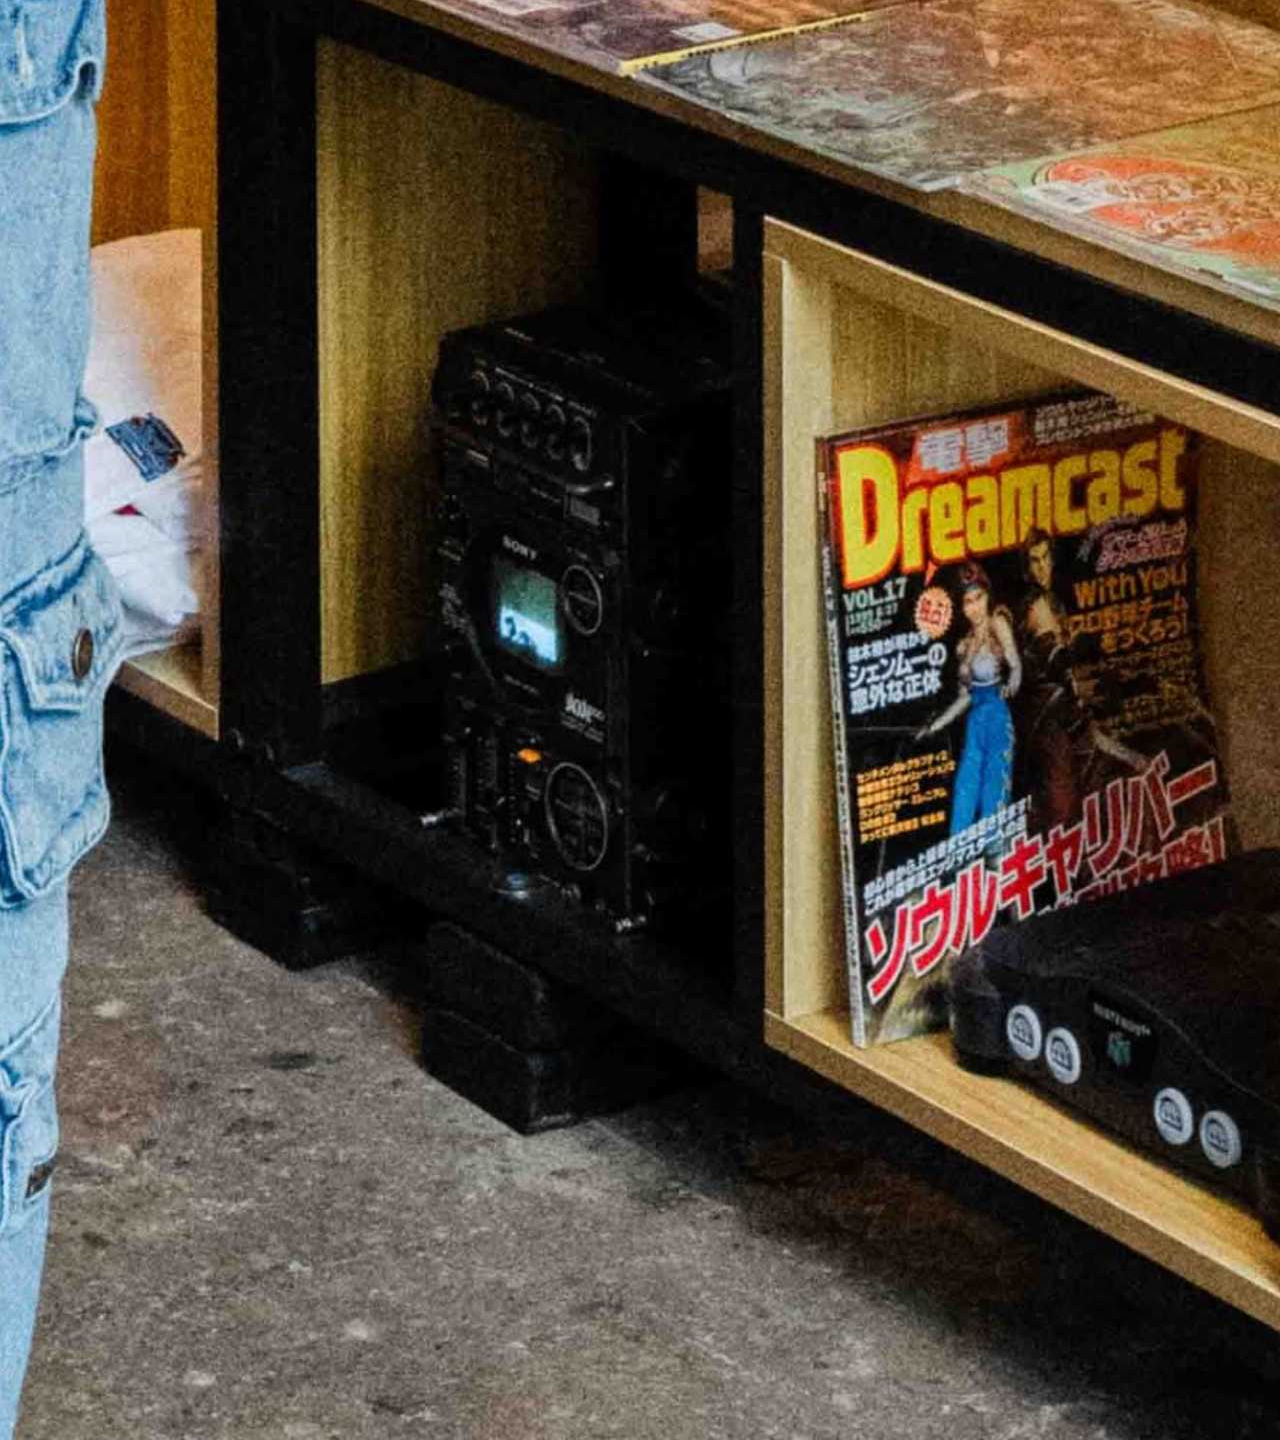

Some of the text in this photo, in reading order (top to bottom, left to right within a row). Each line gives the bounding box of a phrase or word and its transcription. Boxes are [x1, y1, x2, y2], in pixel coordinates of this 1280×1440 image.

[837, 429, 1187, 589] Dreamcast
[843, 577, 907, 613] VOL.17
[1075, 573, 1136, 610] With
[849, 642, 947, 689] シェンムーの
[867, 749, 1217, 1005] ソウルキャリバー
